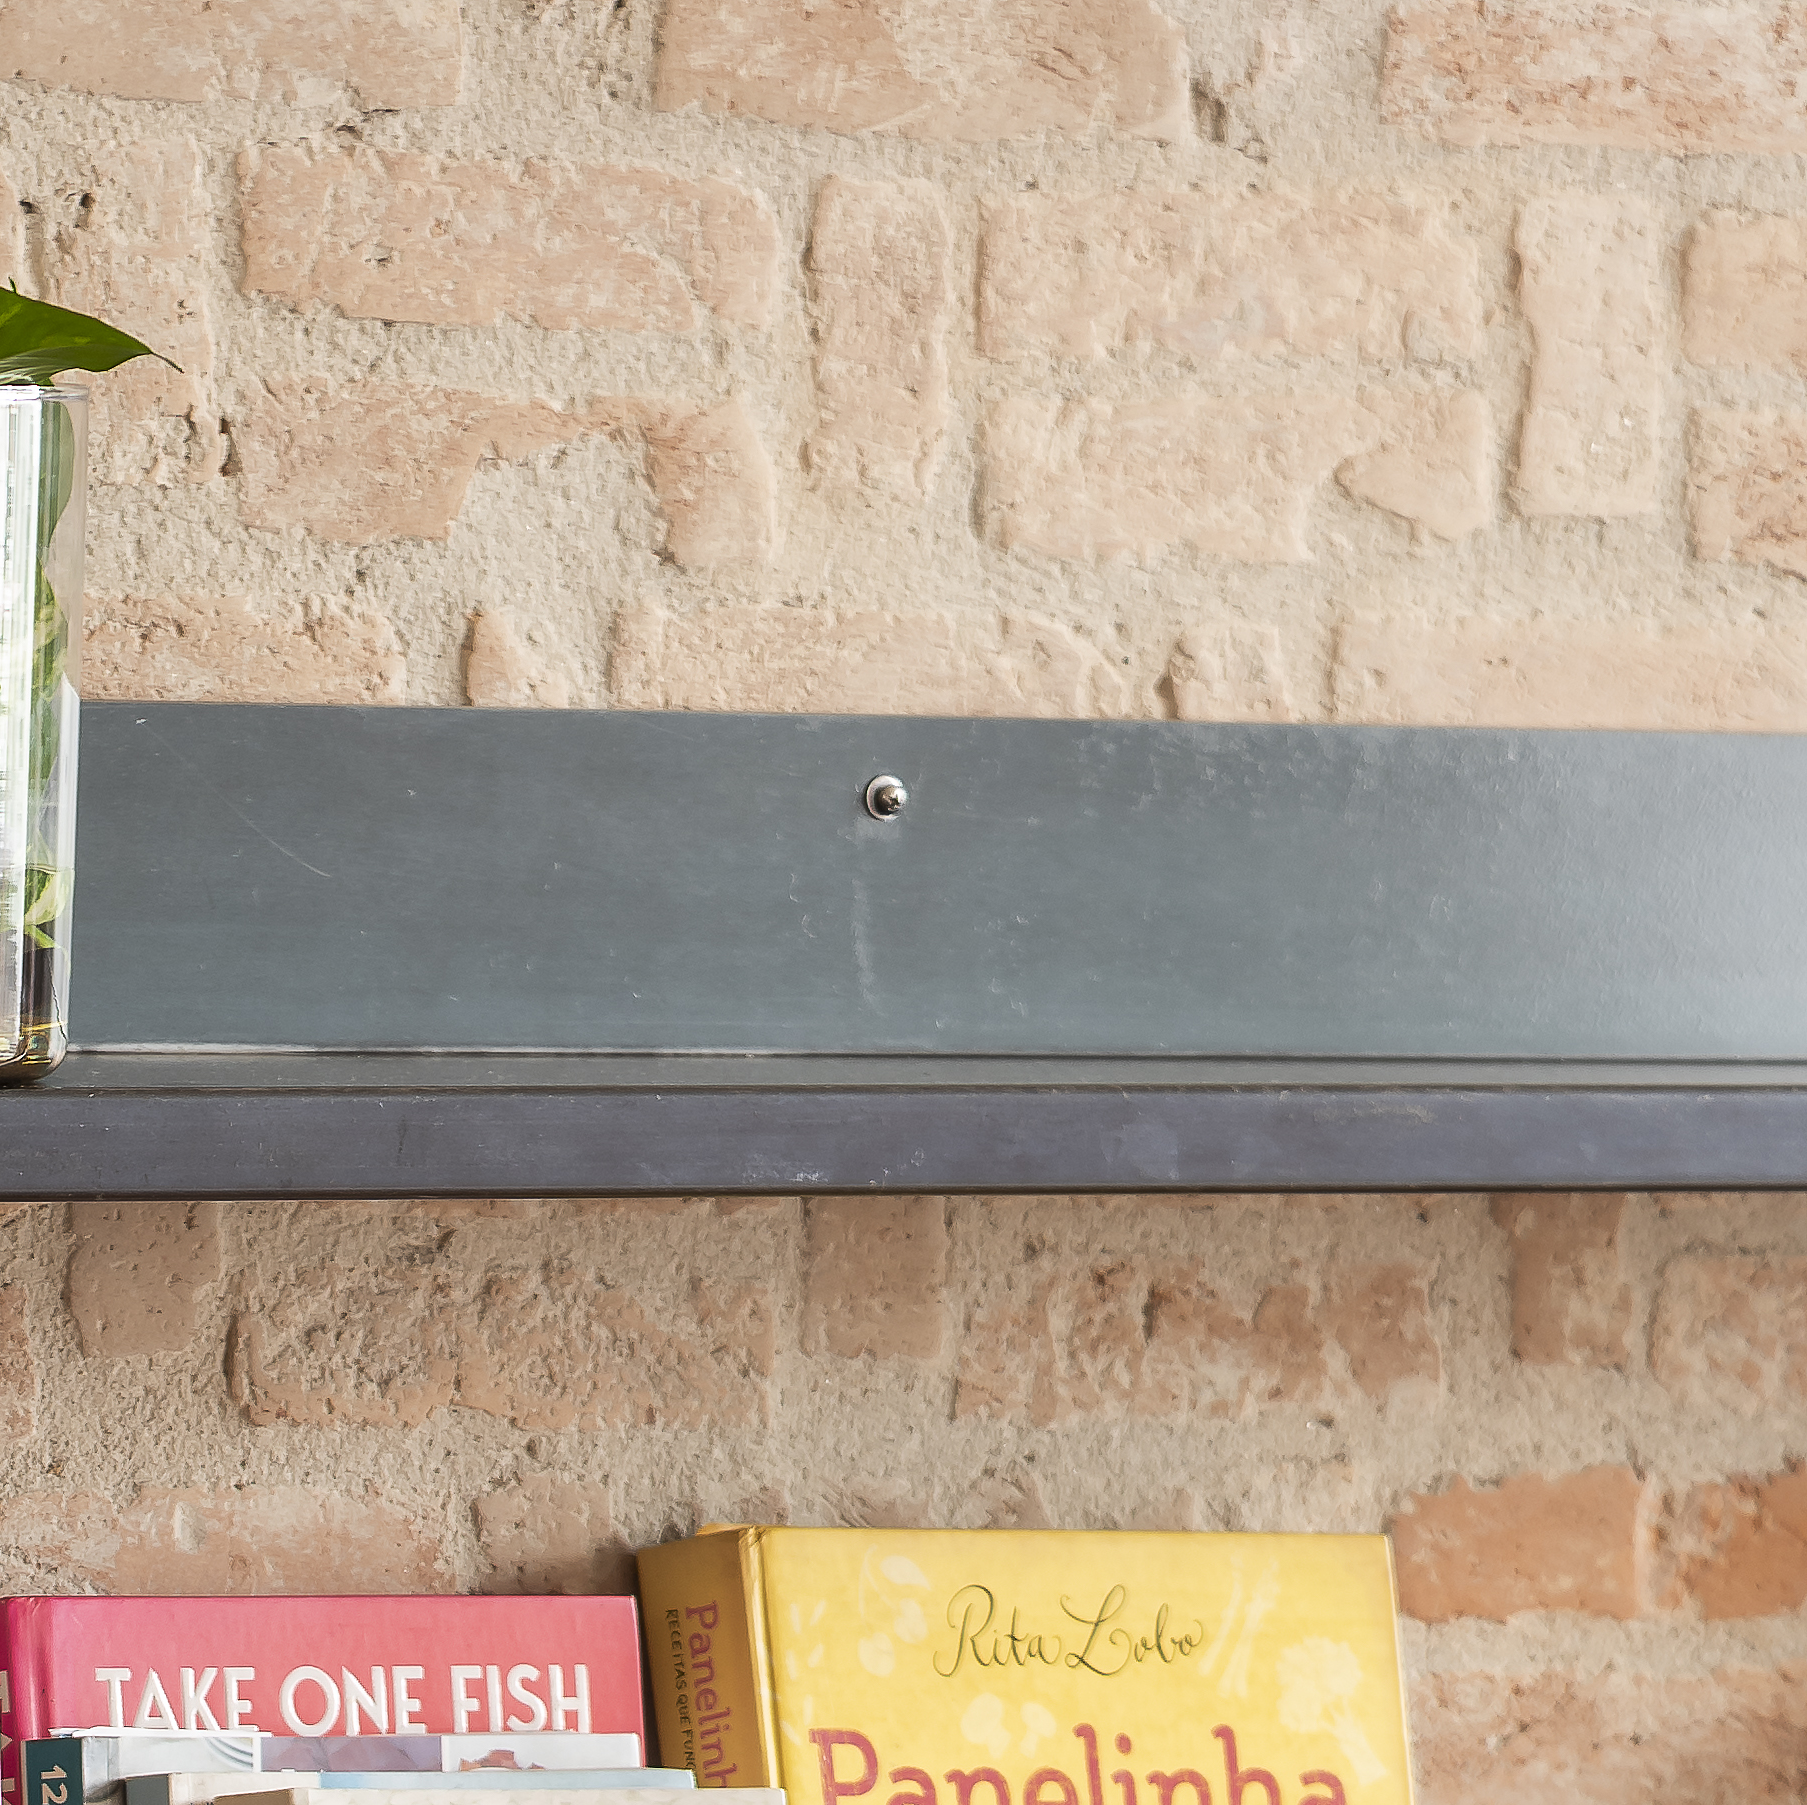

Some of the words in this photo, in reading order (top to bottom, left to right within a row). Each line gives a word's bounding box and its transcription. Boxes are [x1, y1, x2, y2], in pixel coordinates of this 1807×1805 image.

[933, 1584, 1061, 1677] Rita
[1060, 1584, 1203, 1676] Lobo
[95, 1665, 260, 1731] TAKE
[280, 1664, 426, 1737] ONE
[450, 1664, 592, 1734] FISH
[685, 1600, 737, 1788] Panelinh
